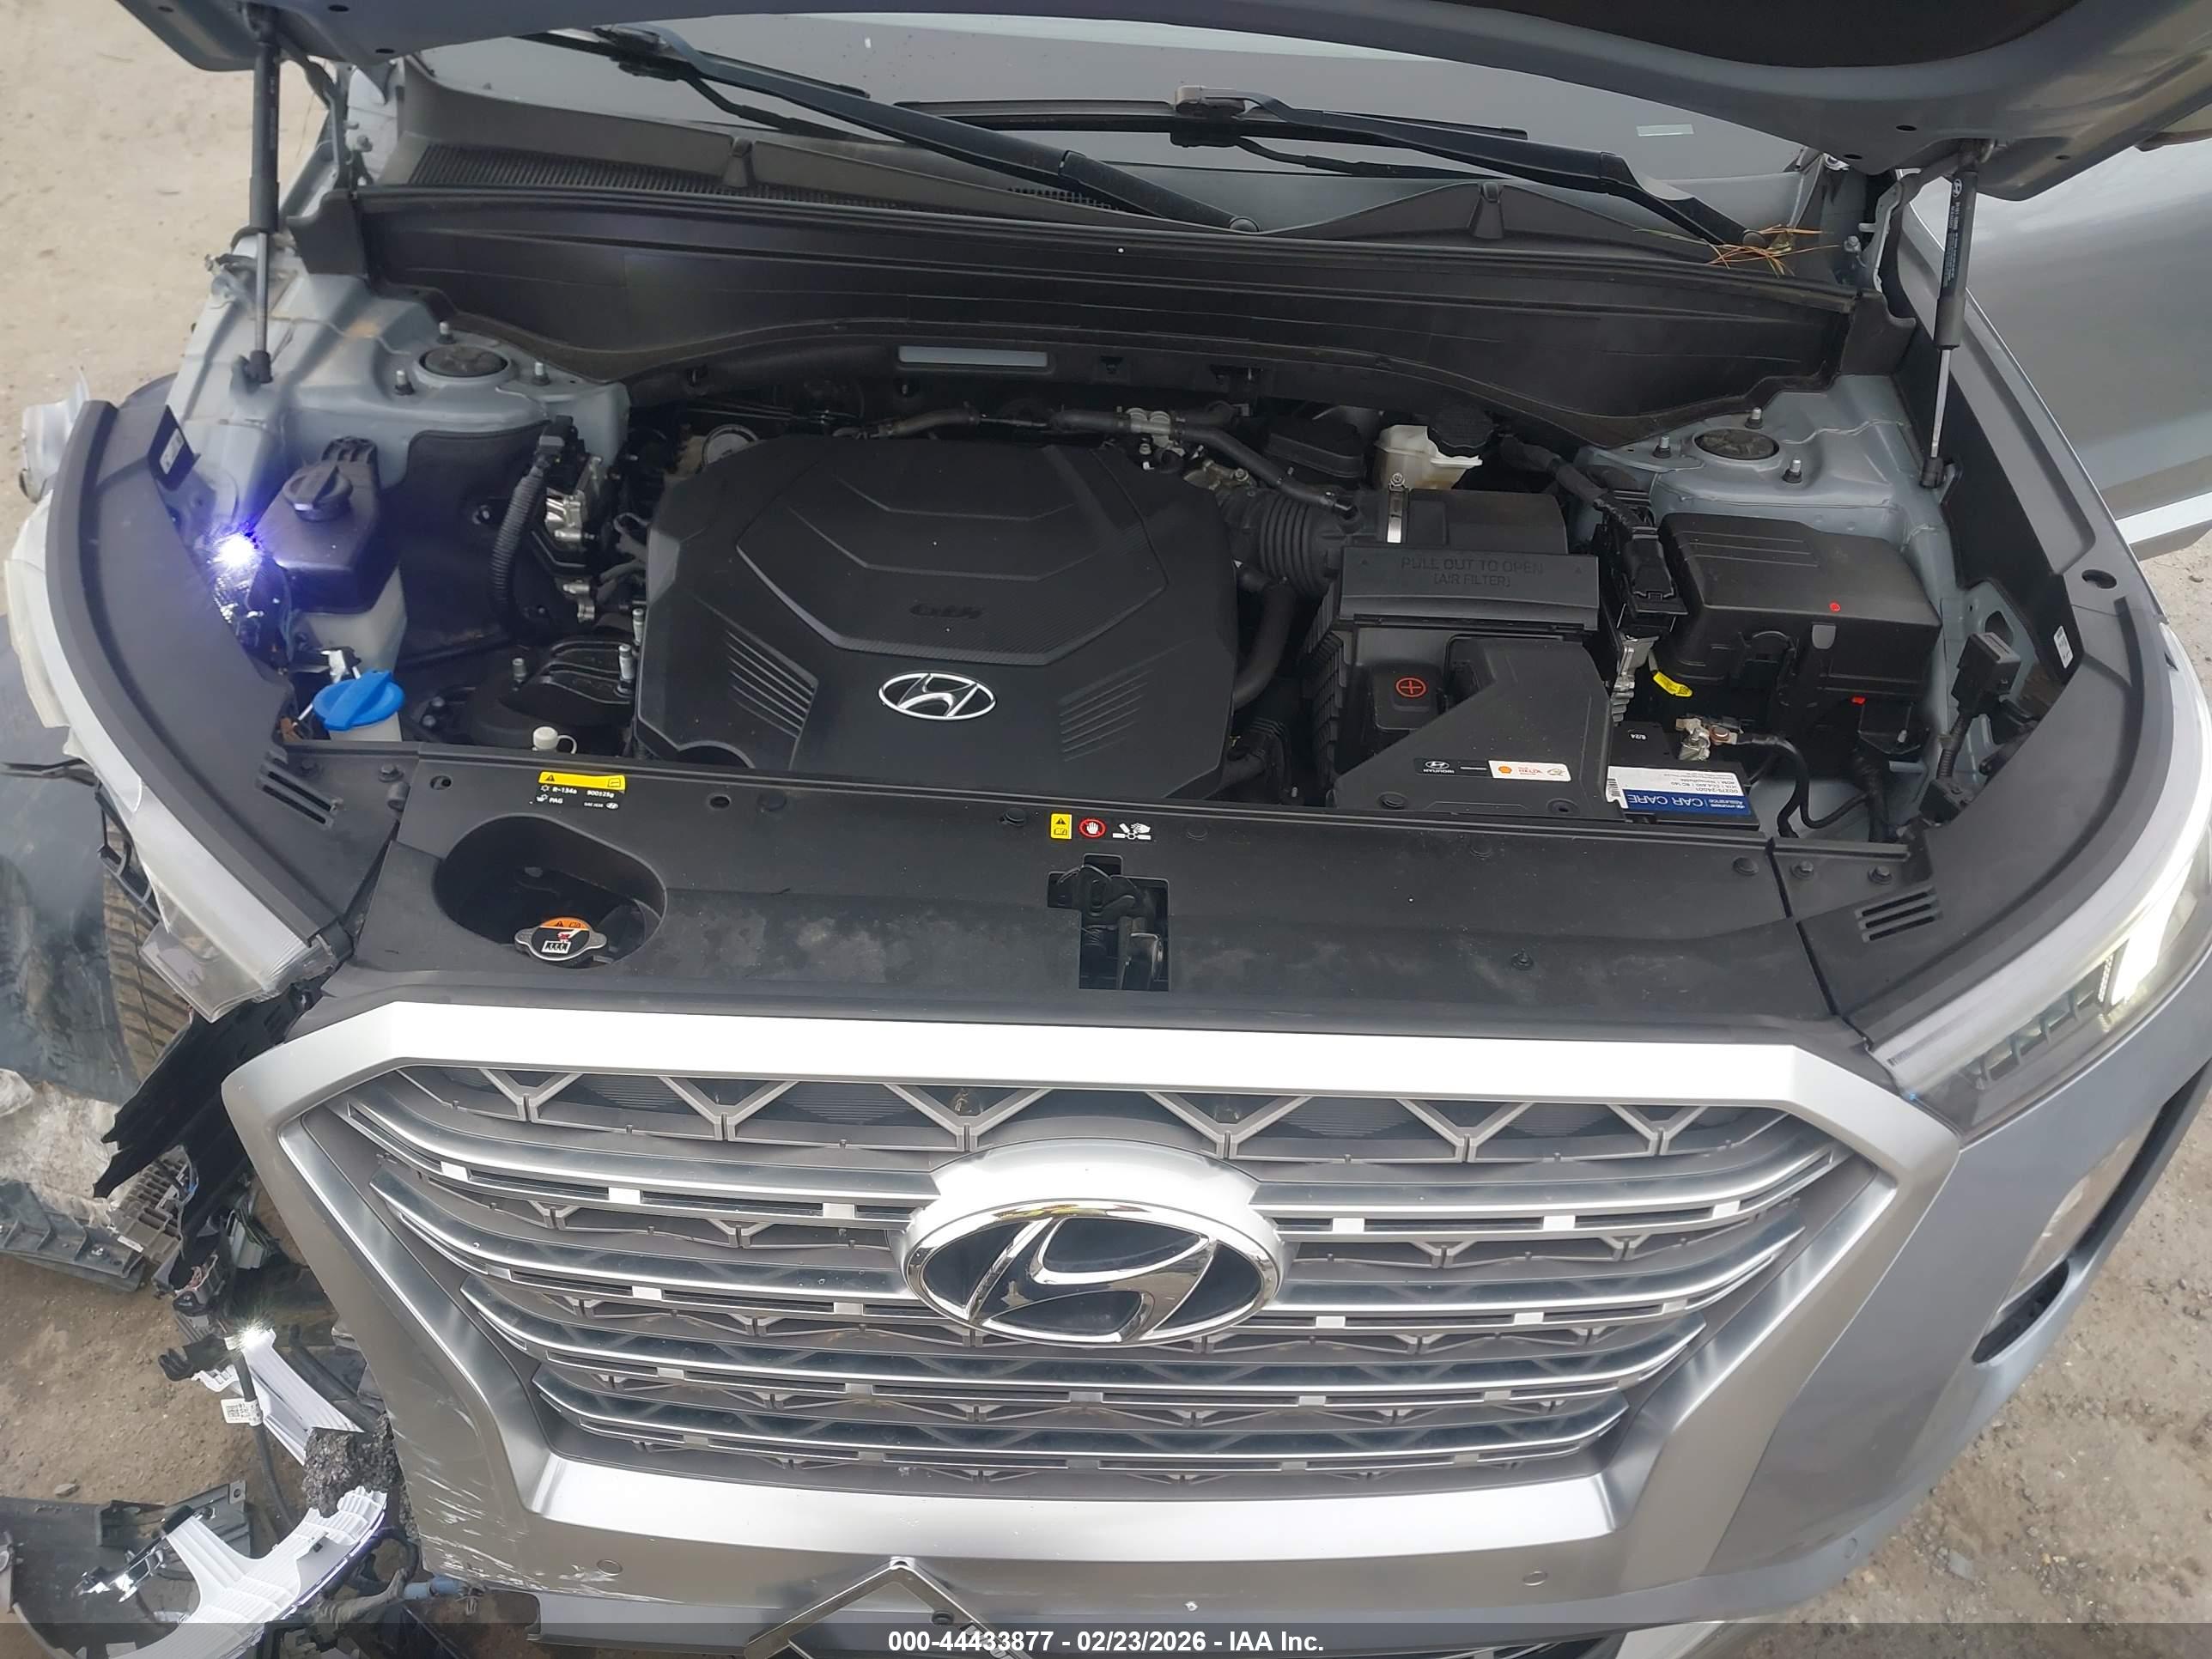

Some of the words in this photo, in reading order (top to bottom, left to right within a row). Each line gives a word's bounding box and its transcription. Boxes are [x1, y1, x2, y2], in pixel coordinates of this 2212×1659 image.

[1401, 556, 1440, 570] PULL
[1443, 558, 1474, 571] OUT
[1480, 559, 1498, 573] TO
[1502, 561, 1544, 575] OPEN
[1627, 794, 1668, 805] CARE
[1671, 797, 1704, 807] CAR
